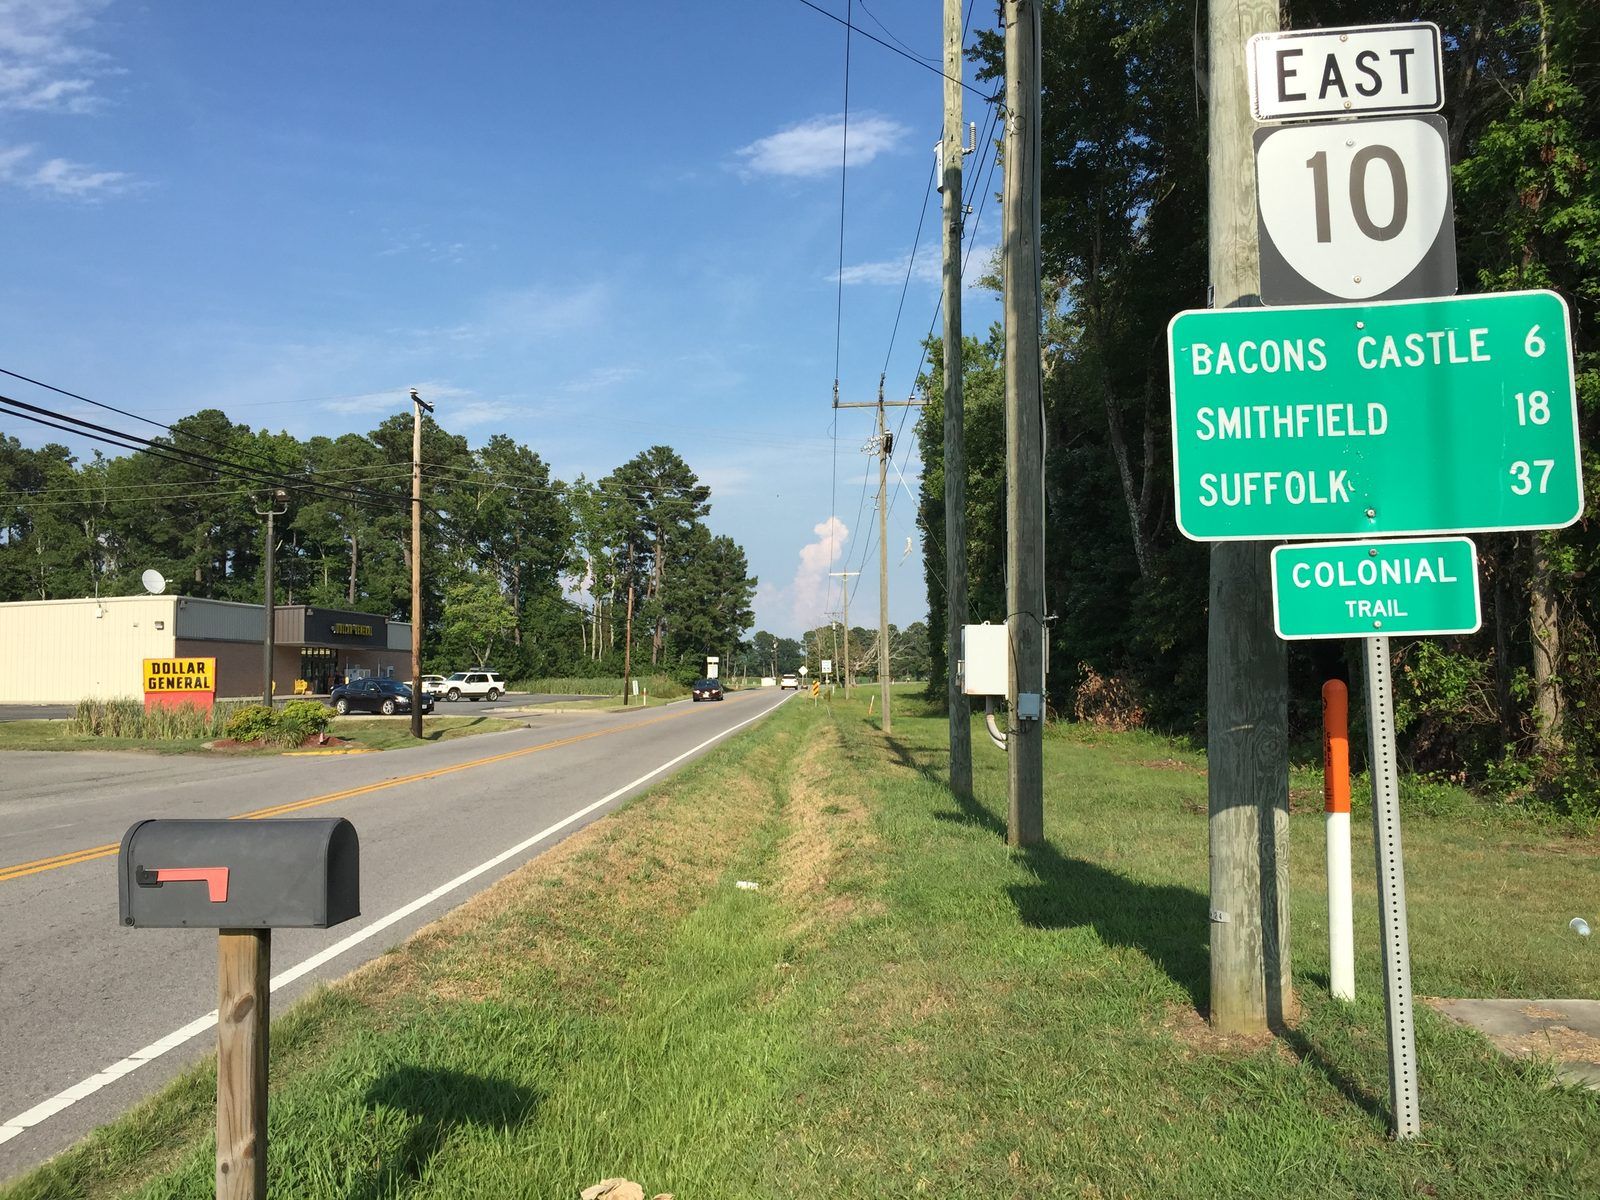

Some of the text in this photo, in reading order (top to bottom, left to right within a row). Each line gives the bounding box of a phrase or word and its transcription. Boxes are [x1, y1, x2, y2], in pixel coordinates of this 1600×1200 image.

[1276, 48, 1415, 103] EAST
[1306, 144, 1408, 243] 10
[1191, 324, 1546, 376] BACONS CASTLE 6
[1196, 390, 1551, 441] SMITHFIELD 18
[1199, 459, 1555, 507] SUFFOLK 37
[1292, 557, 1457, 589] COLONIAL
[1345, 599, 1408, 618] TRAIL
[148, 676, 211, 690] GENERAL
[151, 661, 206, 675] DOLLAR
